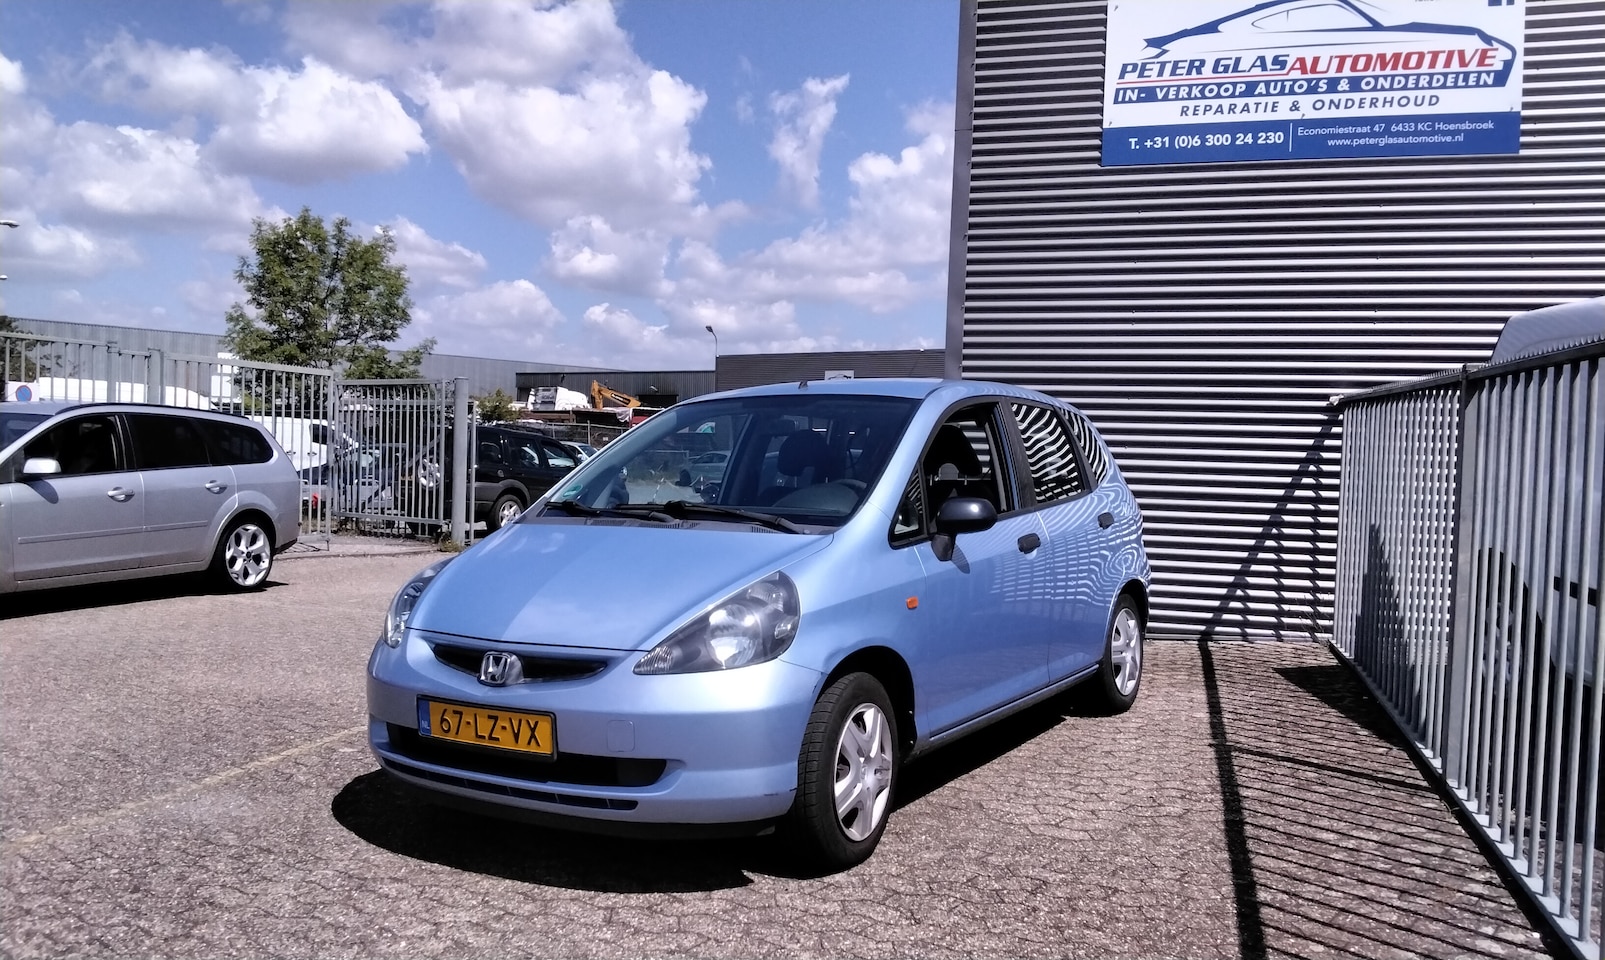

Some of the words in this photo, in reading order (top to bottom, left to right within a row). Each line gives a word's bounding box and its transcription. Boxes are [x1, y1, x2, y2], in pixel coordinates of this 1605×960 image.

[1118, 58, 1207, 80] PETER
[1117, 88, 1146, 102] IN-
[1155, 83, 1247, 100] VERKOOP
[1254, 79, 1328, 95] AUTO'S
[1337, 78, 1350, 91] &
[1361, 72, 1495, 90] ONDERDELEN
[1180, 101, 1280, 117] REPARATIE
[1289, 100, 1301, 112] &
[1312, 94, 1440, 111] ONDERHOUD
[1297, 125, 1371, 136] Economiestraat
[1373, 123, 1386, 133] 47
[1391, 122, 1415, 132] 6433
[1418, 121, 1433, 132] KC
[1435, 120, 1495, 132] Hoensbroek
[1128, 138, 1140, 150] T.
[1144, 136, 1170, 149] +31
[1174, 135, 1201, 149] (0)6
[1205, 134, 1232, 147] 300
[1235, 133, 1253, 145] 24
[1257, 131, 1284, 144] 230
[1328, 133, 1464, 147] www.peterglasautomotive.nl
[440, 708, 541, 747] 67-LZ-VX
